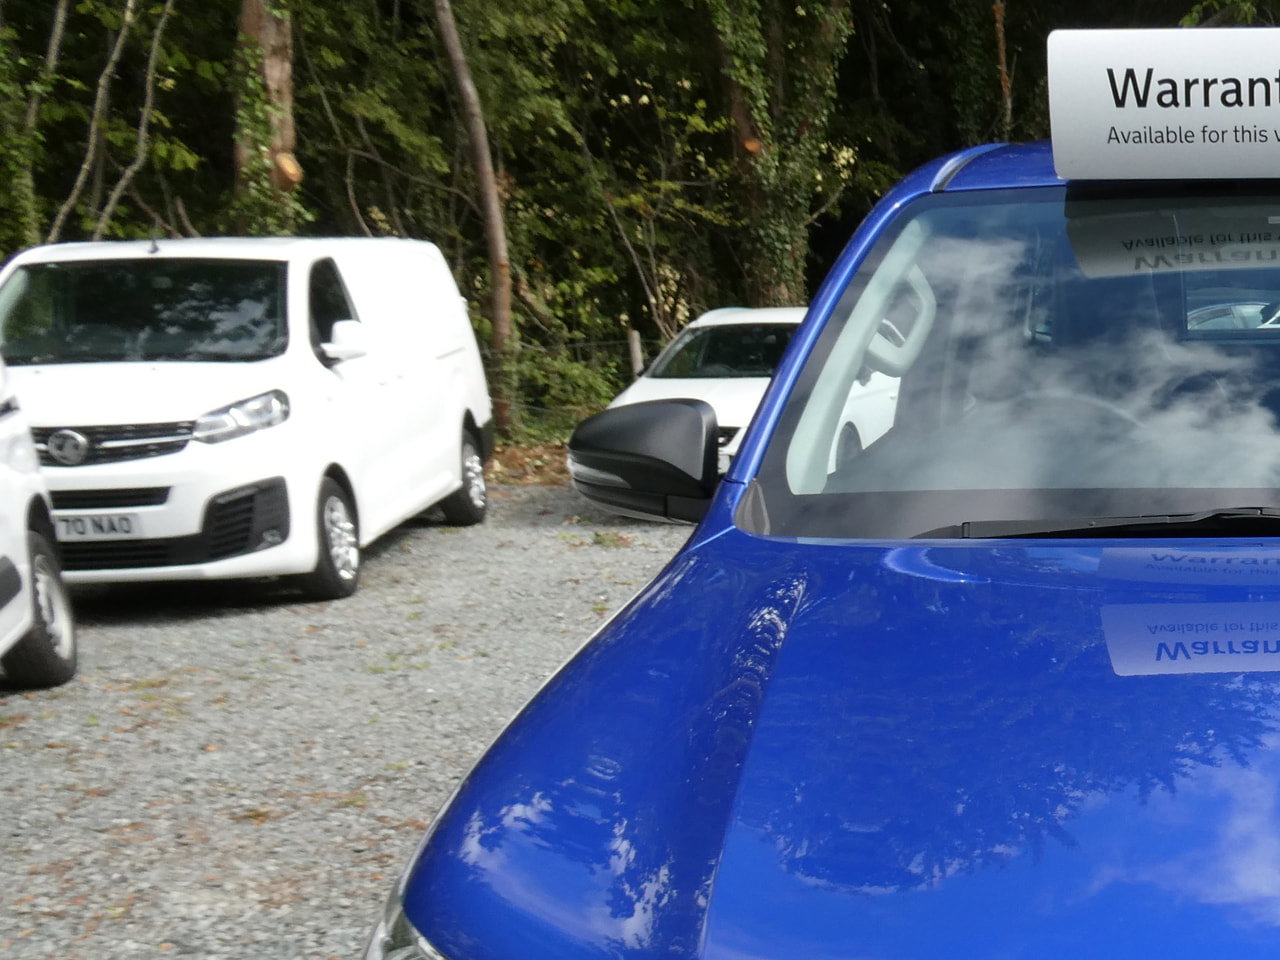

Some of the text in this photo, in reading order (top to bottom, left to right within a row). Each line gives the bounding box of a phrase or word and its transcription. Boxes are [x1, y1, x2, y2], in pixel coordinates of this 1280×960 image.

[1106, 126, 1195, 145] Available
[1200, 126, 1229, 144] for
[1232, 125, 1268, 143] this
